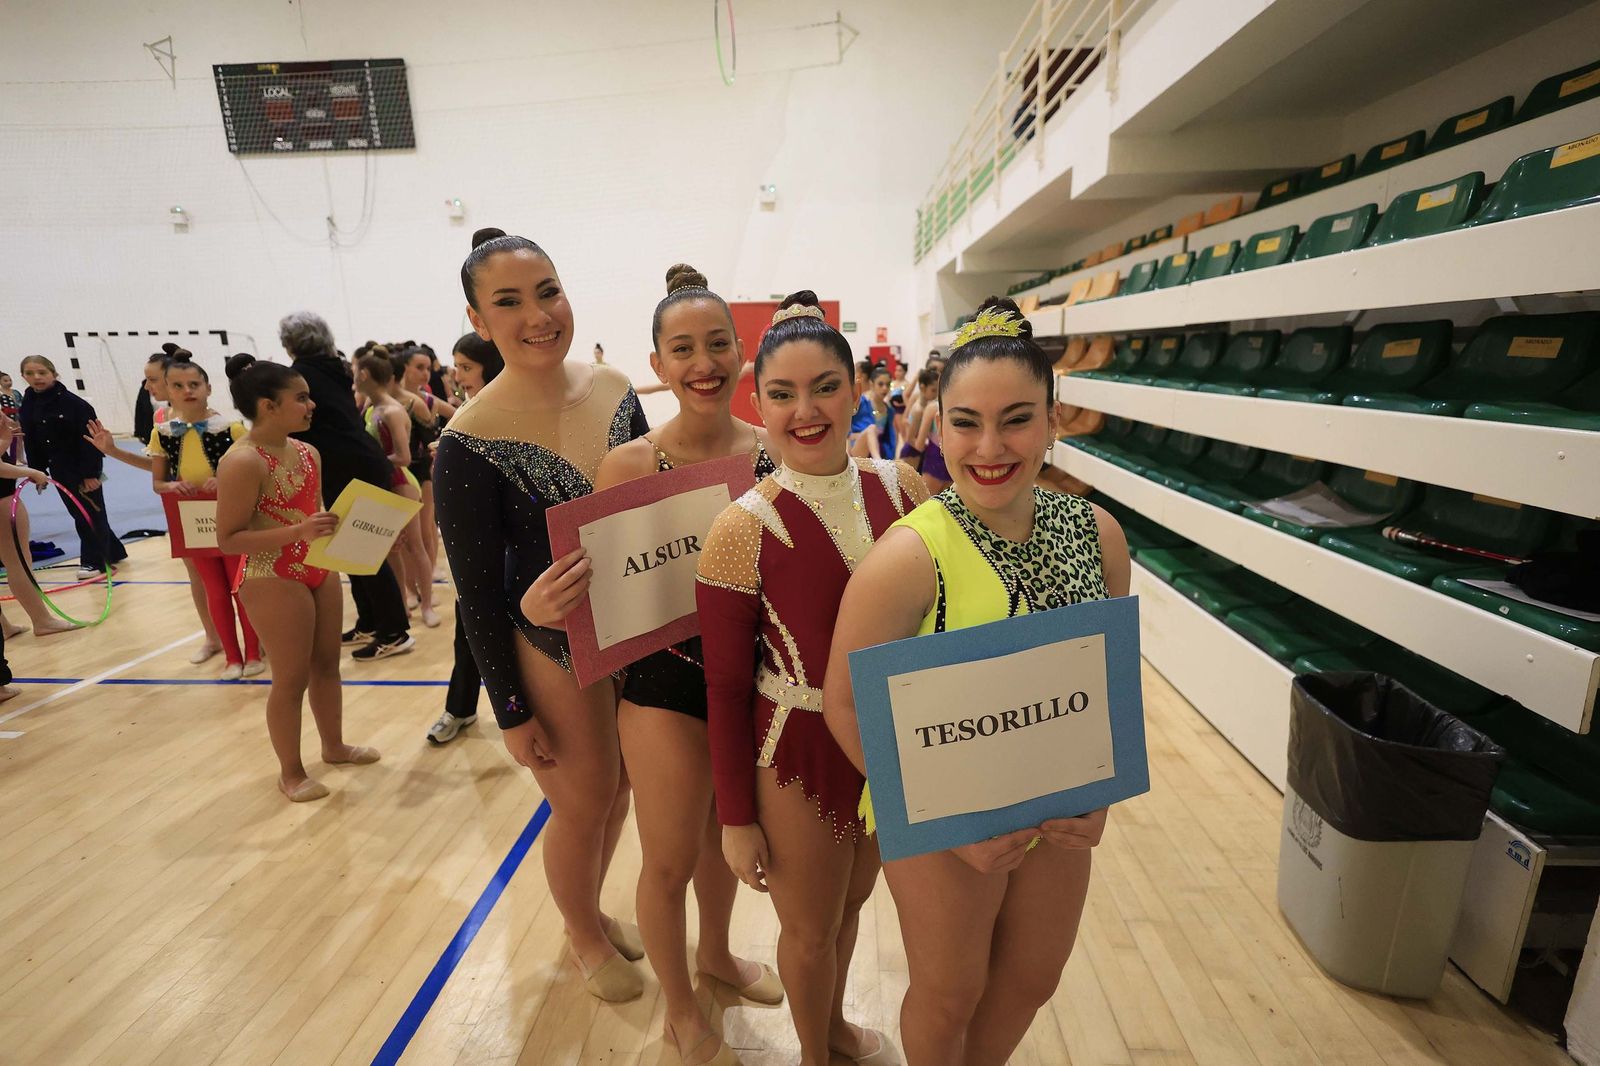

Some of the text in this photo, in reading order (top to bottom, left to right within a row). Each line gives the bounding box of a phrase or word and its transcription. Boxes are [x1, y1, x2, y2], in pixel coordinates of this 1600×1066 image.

[263, 87, 291, 97] LOCAL
[622, 535, 702, 577] ALSUR
[915, 691, 1089, 748] TESORILLO
